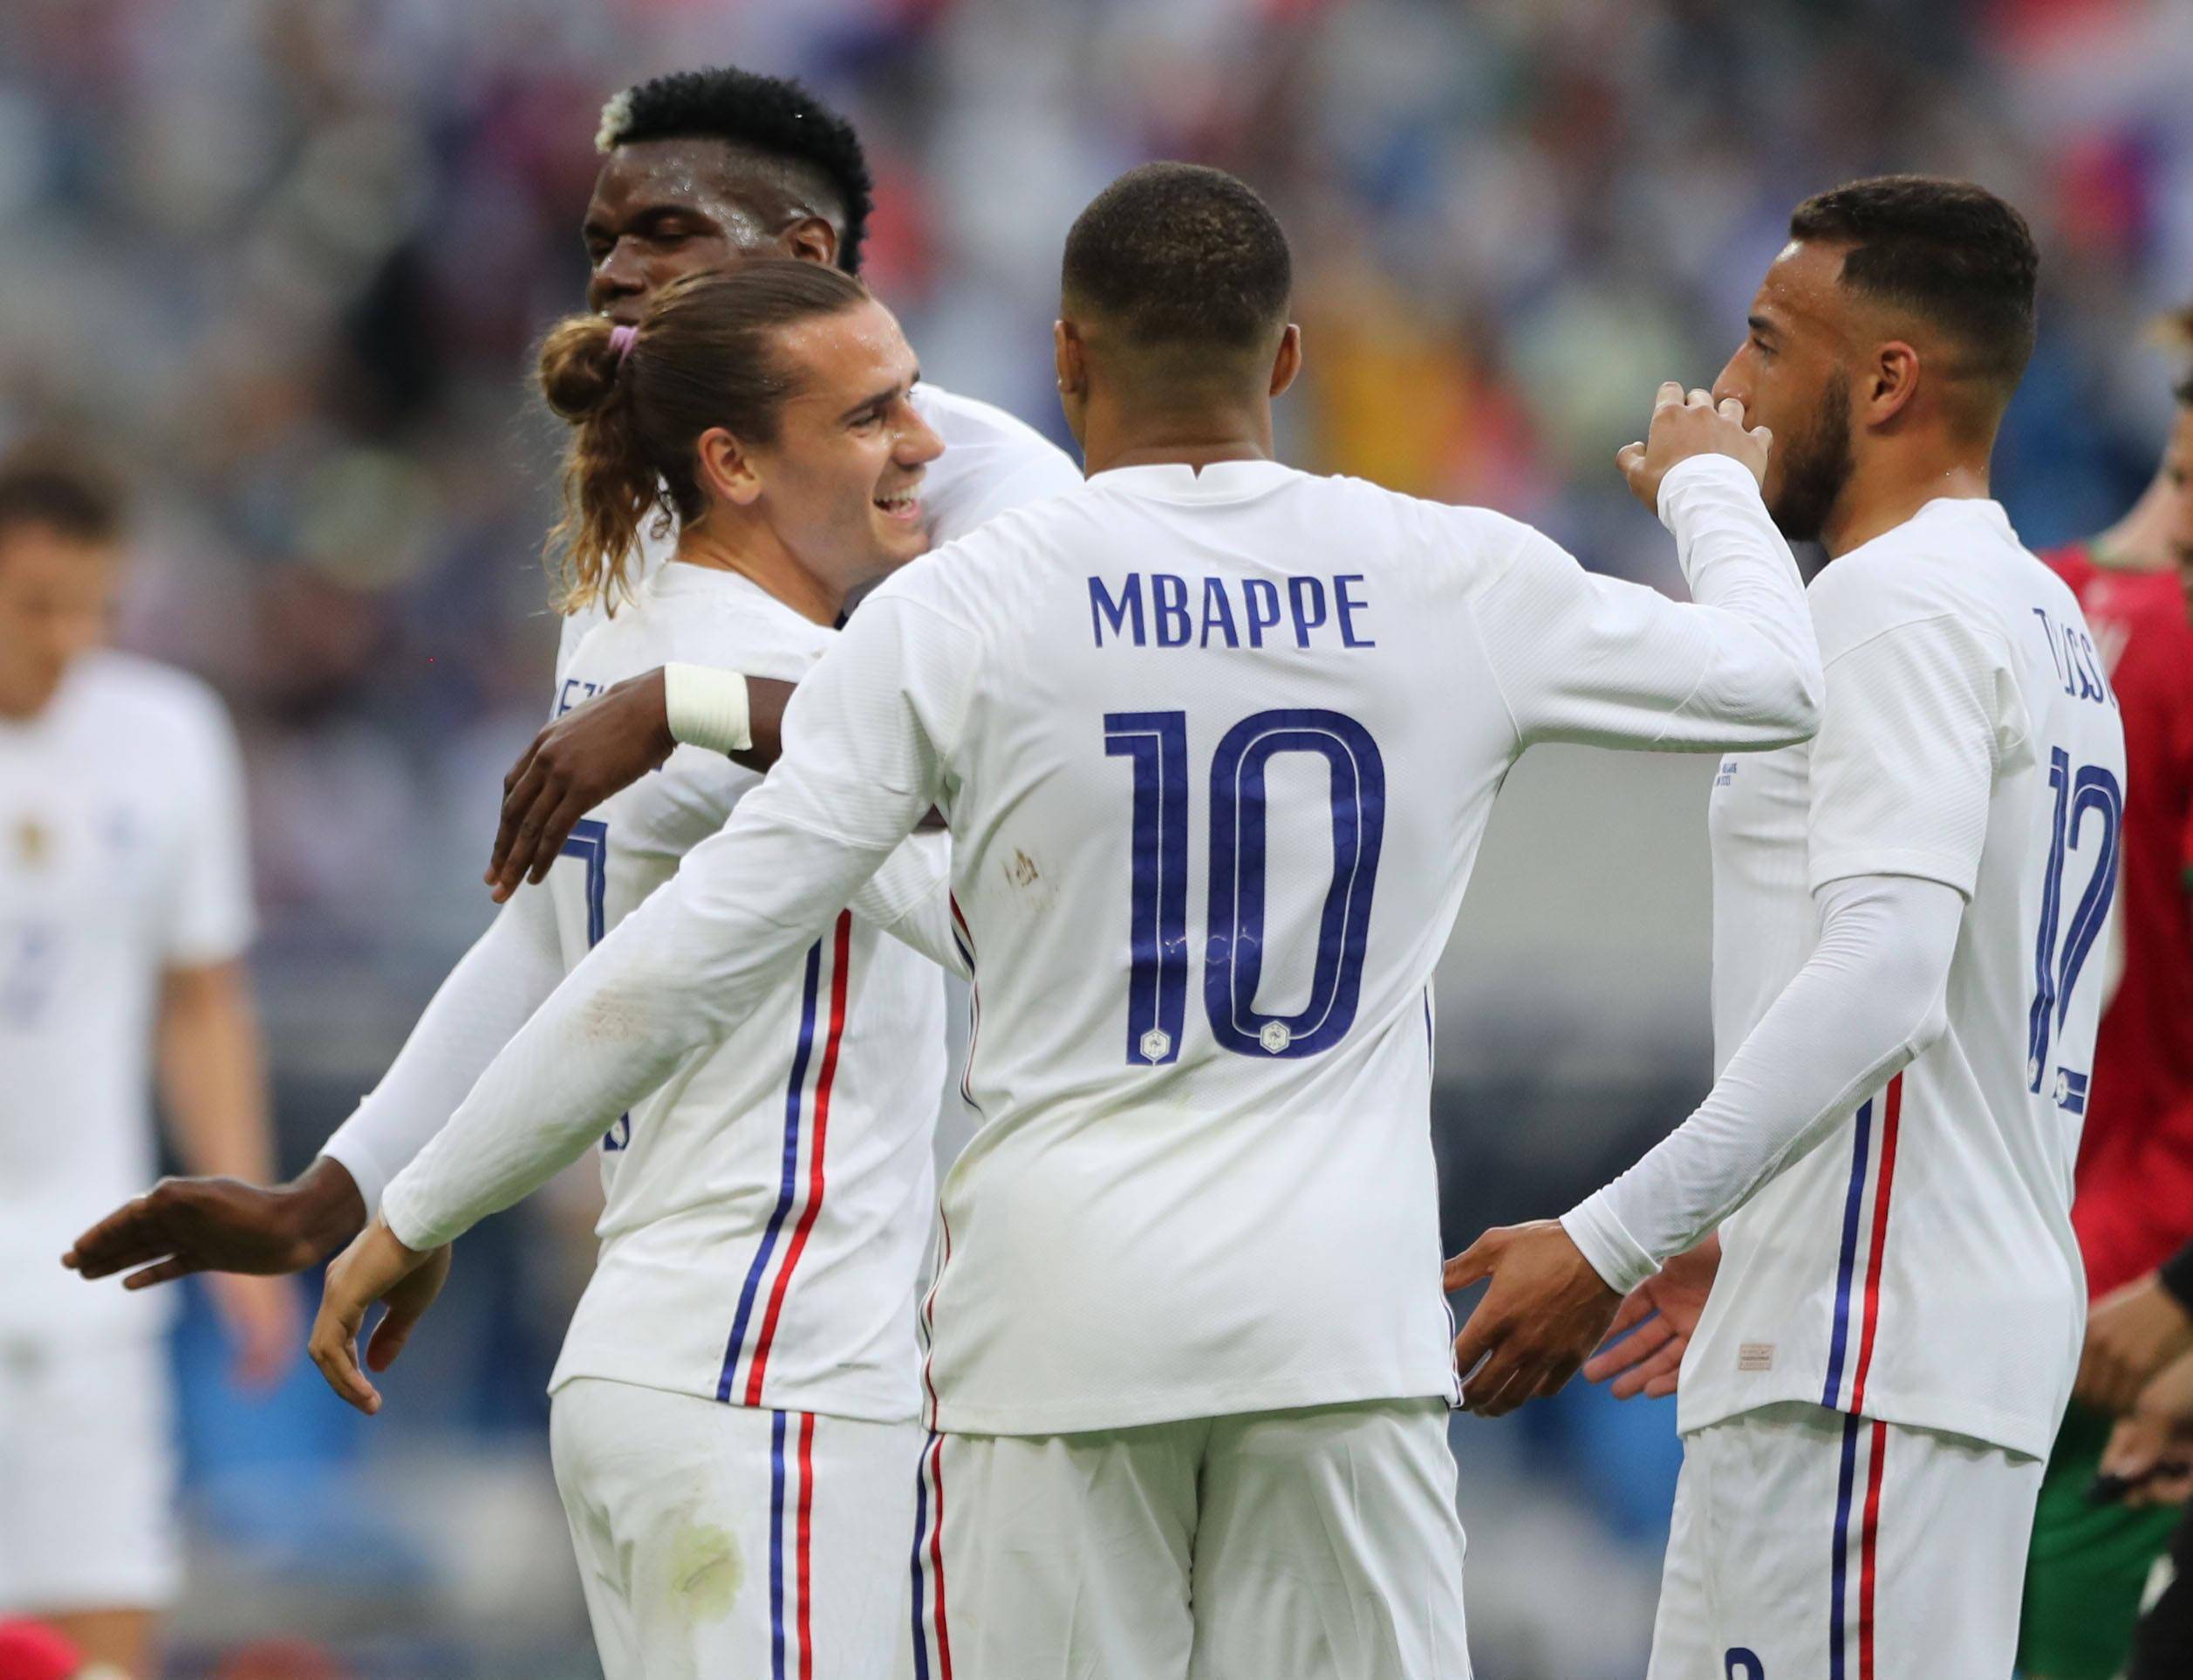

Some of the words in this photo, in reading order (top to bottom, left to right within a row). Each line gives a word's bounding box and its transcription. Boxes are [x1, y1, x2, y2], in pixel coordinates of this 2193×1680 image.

[1088, 572, 1376, 649] MBAPPE
[1103, 708, 1386, 1066] 10
[2027, 746, 2122, 1115] 12
